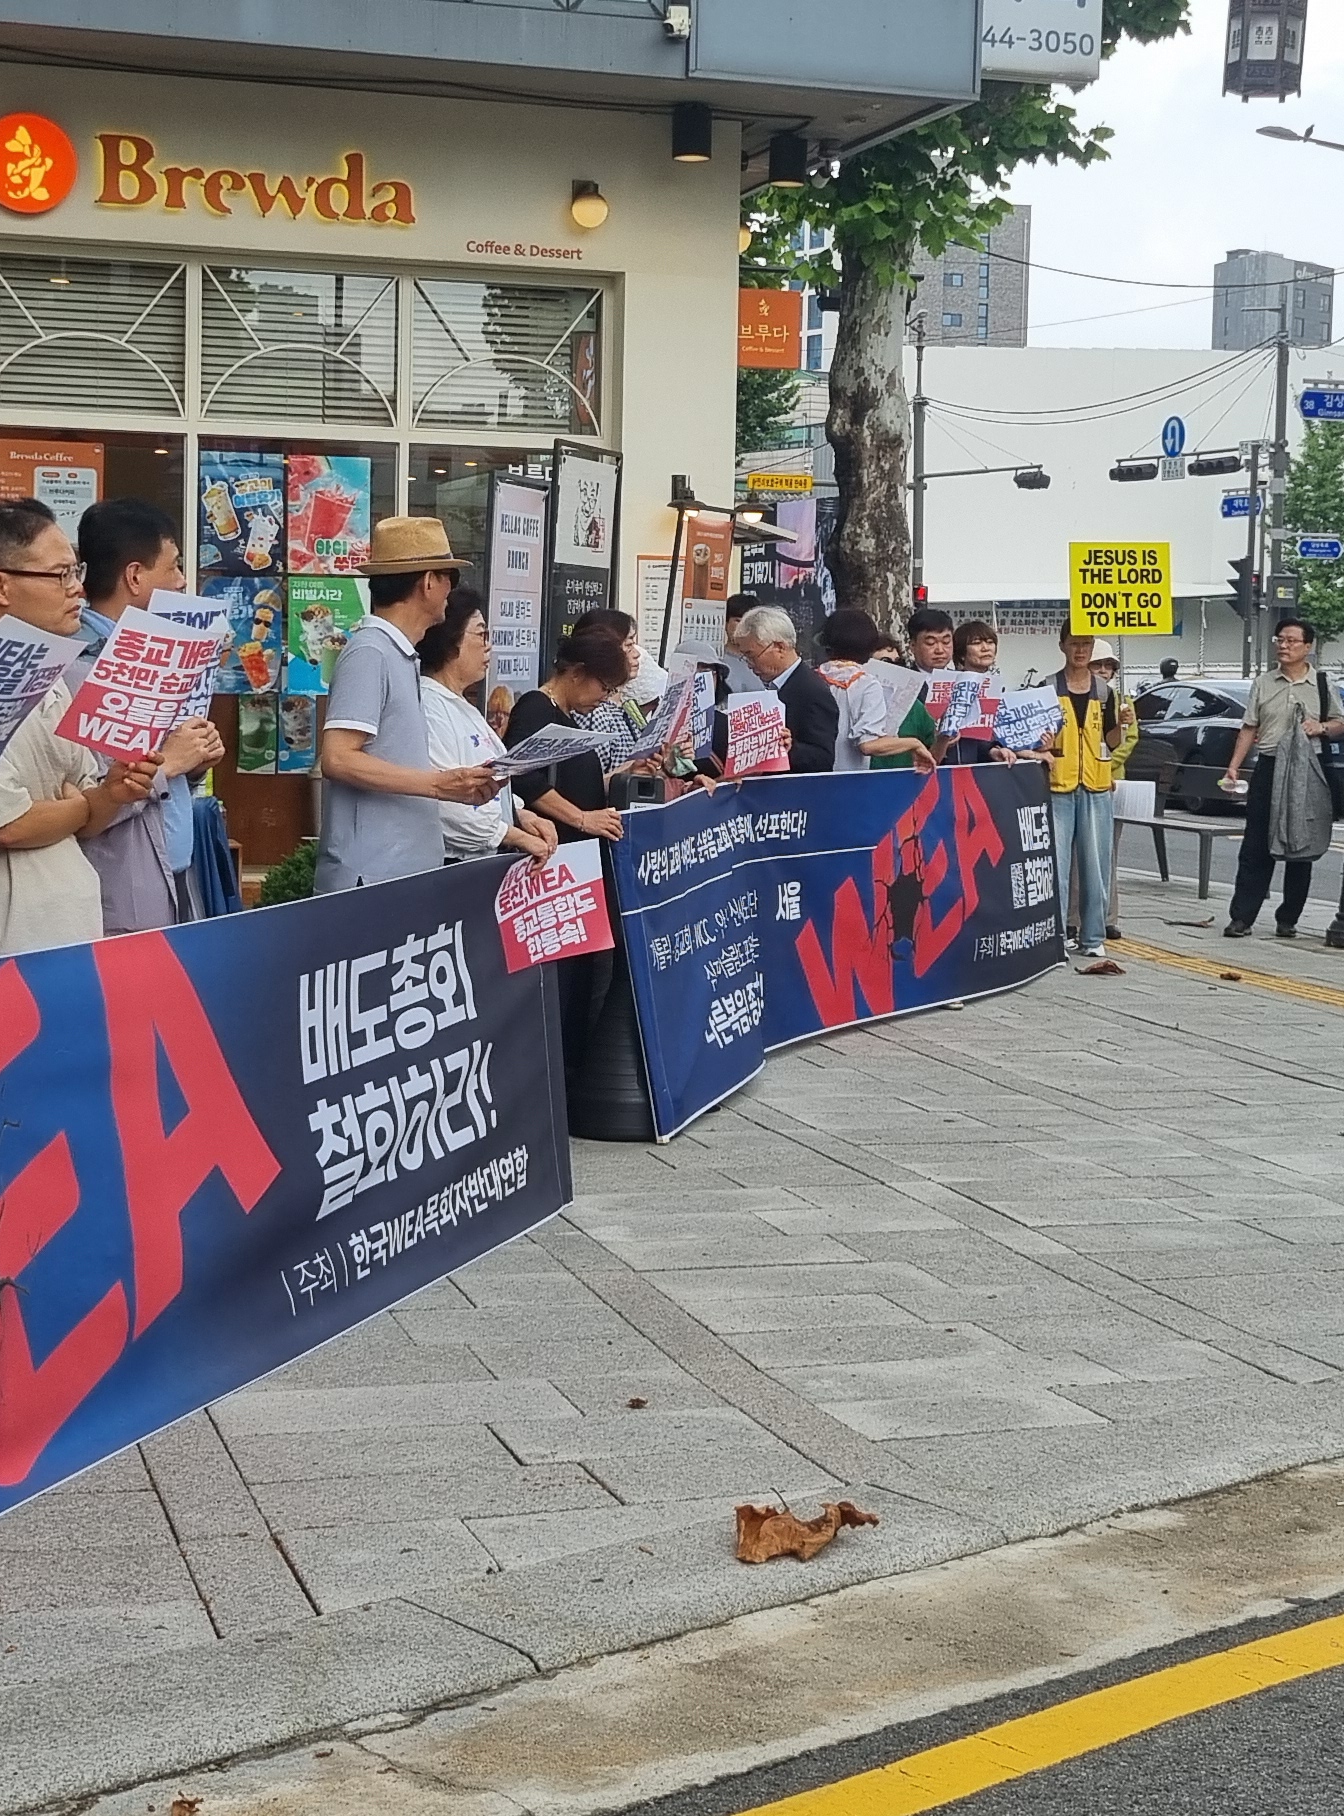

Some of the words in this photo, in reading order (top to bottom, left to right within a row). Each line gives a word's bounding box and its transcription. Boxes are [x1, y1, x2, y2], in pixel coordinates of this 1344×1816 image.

[94, 132, 418, 226] Brewda
[466, 238, 510, 258] Coffee
[514, 242, 525, 256] &
[529, 243, 583, 263] Dessert
[738, 324, 790, 343] 브루다
[1303, 400, 1315, 411] 38
[1083, 549, 1137, 567] JESUS
[1141, 549, 1158, 566] IS
[1079, 568, 1113, 586] THE
[1117, 567, 1163, 586] LORD
[1081, 591, 1133, 610] DON'T
[1137, 592, 1162, 610] GO
[1087, 612, 1110, 629] TO
[1114, 611, 1157, 628] HELL
[93, 659, 160, 692] 5천만
[96, 691, 183, 730] 오물을
[755, 809, 808, 843] 선포한다!
[775, 881, 802, 921] 서울
[795, 766, 1004, 1028] WEA
[513, 886, 598, 943] 종교통합도
[526, 917, 588, 963] 한통속!
[694, 918, 717, 949] WCC
[299, 920, 479, 1086] 배도총회
[307, 1040, 500, 1221] 철회하라!
[293, 1248, 338, 1306] 주최
[348, 1145, 529, 1280] 한국WEA목회자반대연합
